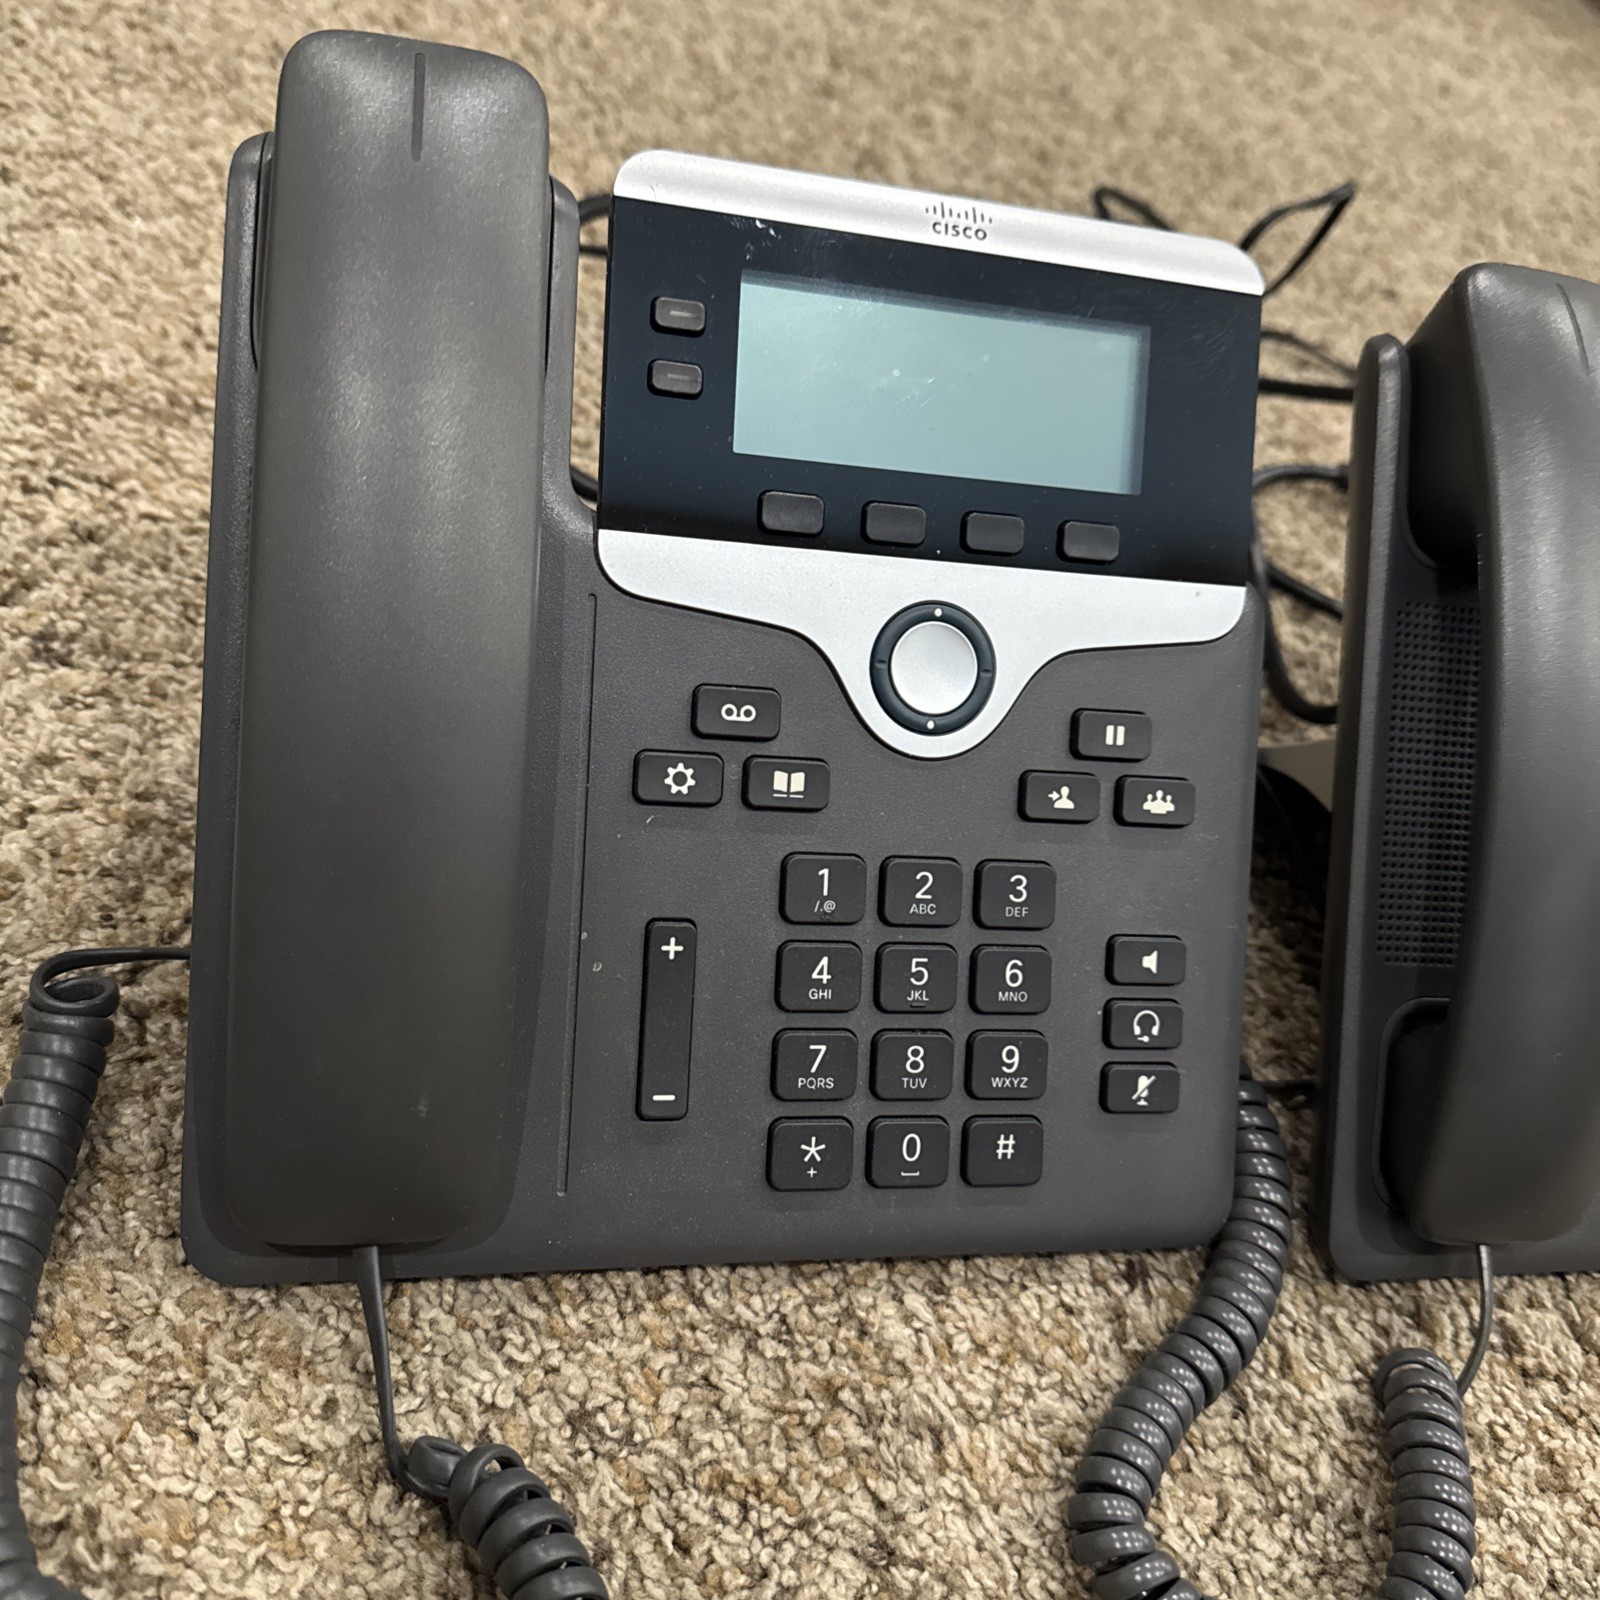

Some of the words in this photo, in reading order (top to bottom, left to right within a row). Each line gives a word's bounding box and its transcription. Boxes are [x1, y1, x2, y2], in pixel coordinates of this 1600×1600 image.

[932, 221, 988, 241] CISCO
[818, 868, 830, 897] 1
[915, 871, 934, 900] 2
[1008, 874, 1028, 903] 3
[909, 903, 937, 915] ABC
[1005, 906, 1029, 918] DEF
[811, 956, 832, 985] 4
[910, 957, 929, 986] 5
[1005, 959, 1023, 988] 6
[808, 988, 832, 1000] GHI
[906, 989, 930, 1001] JKL
[998, 991, 1028, 1002] MNO
[809, 1044, 827, 1074] 7
[905, 1045, 925, 1074] 8
[1001, 1045, 1020, 1074] 9
[797, 1077, 835, 1090] PQRS
[901, 1077, 928, 1089] TUV
[991, 1076, 1029, 1089] WXYZ
[902, 1133, 921, 1162] 0
